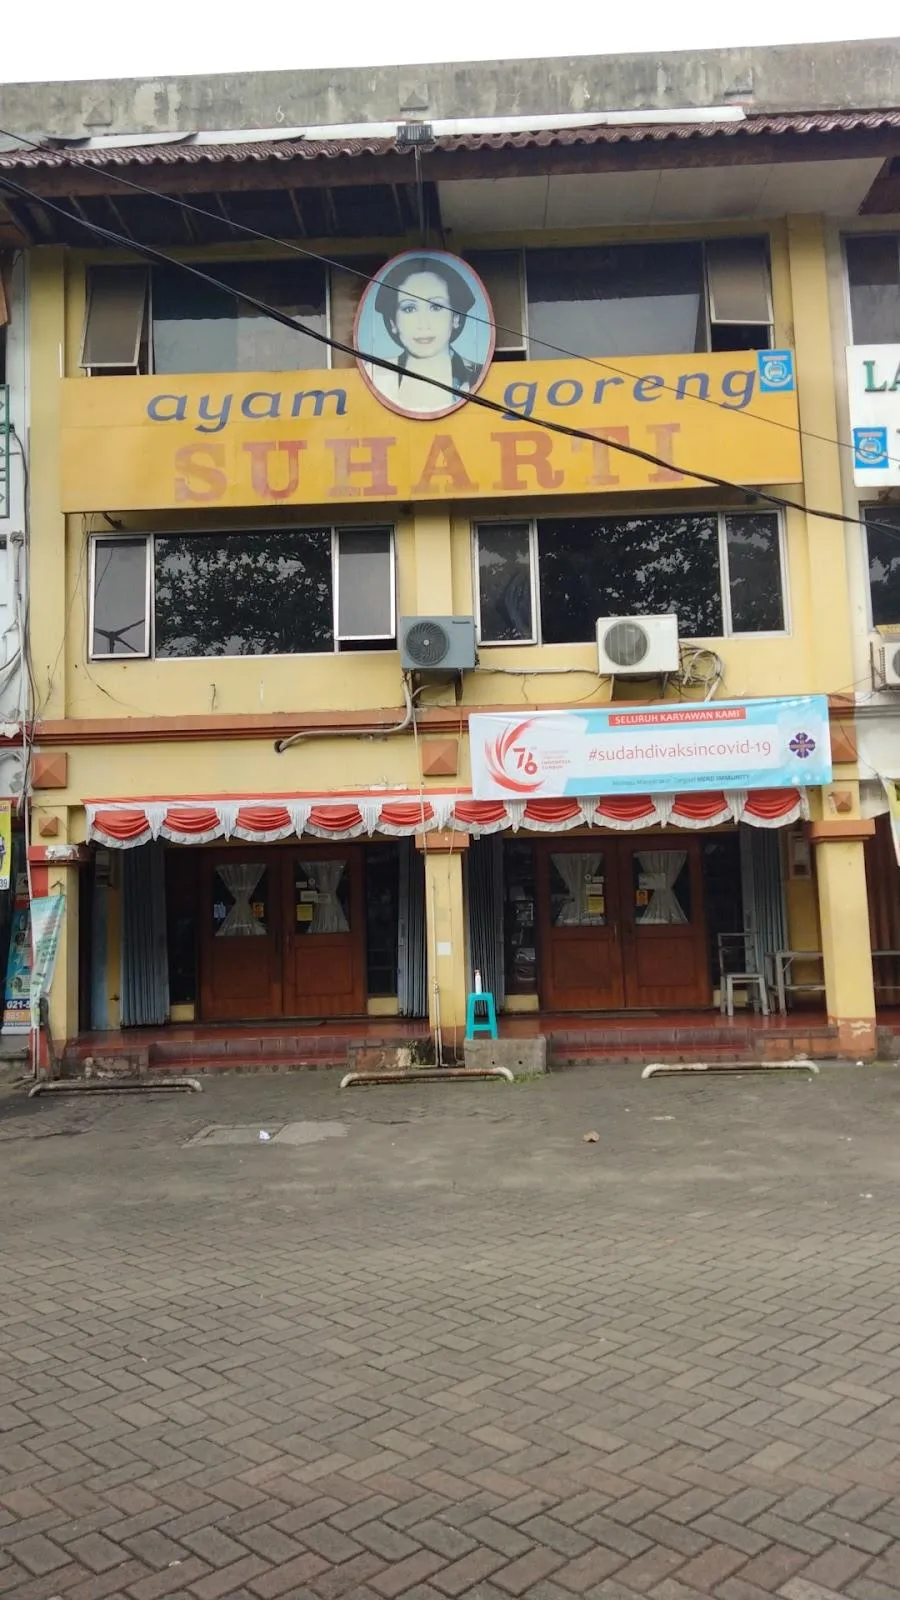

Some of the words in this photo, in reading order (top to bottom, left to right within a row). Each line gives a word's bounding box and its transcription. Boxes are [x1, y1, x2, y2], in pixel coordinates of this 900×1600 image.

[147, 388, 347, 433] ayam
[501, 366, 756, 420] goreng
[174, 423, 685, 502] SUHARTI
[615, 713, 658, 725] SELURUH
[660, 710, 713, 722] KARYAWAN
[716, 708, 740, 719] KAMI
[512, 748, 539, 775] 76
[588, 738, 772, 762] #sudahdivaksincovid-19
